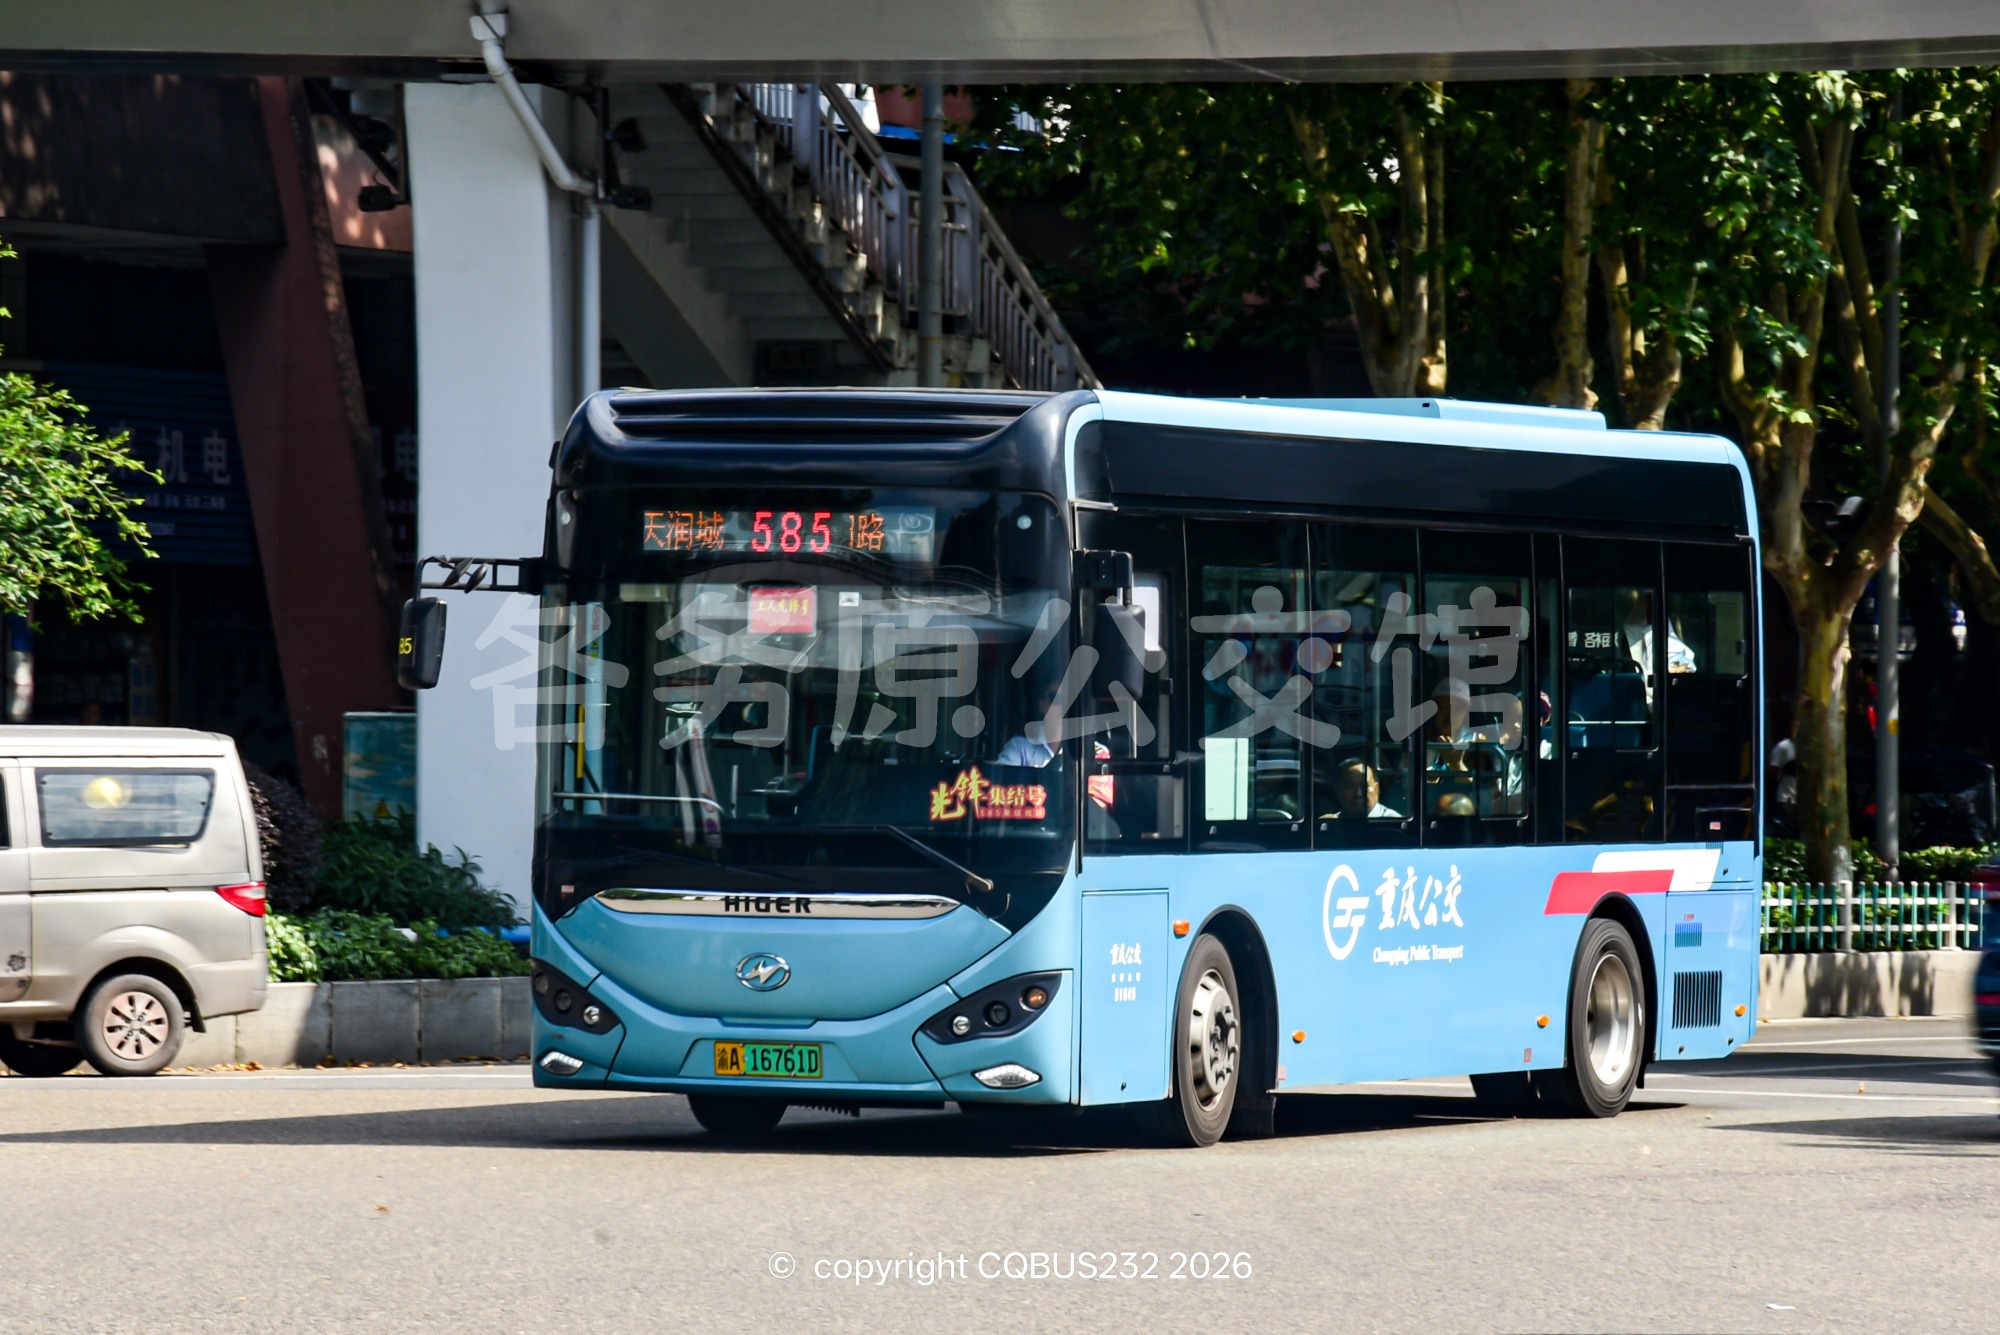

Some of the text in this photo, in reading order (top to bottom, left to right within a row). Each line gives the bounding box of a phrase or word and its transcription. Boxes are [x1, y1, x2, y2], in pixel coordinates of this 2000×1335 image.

[644, 510, 725, 550] 天润城
[751, 511, 831, 552] 585
[724, 896, 811, 913] HIGER
[1375, 864, 1464, 931] 重庆公交
[1410, 945, 1431, 961] Public
[1431, 944, 1464, 963] Transport
[751, 1048, 819, 1073] 16761D
